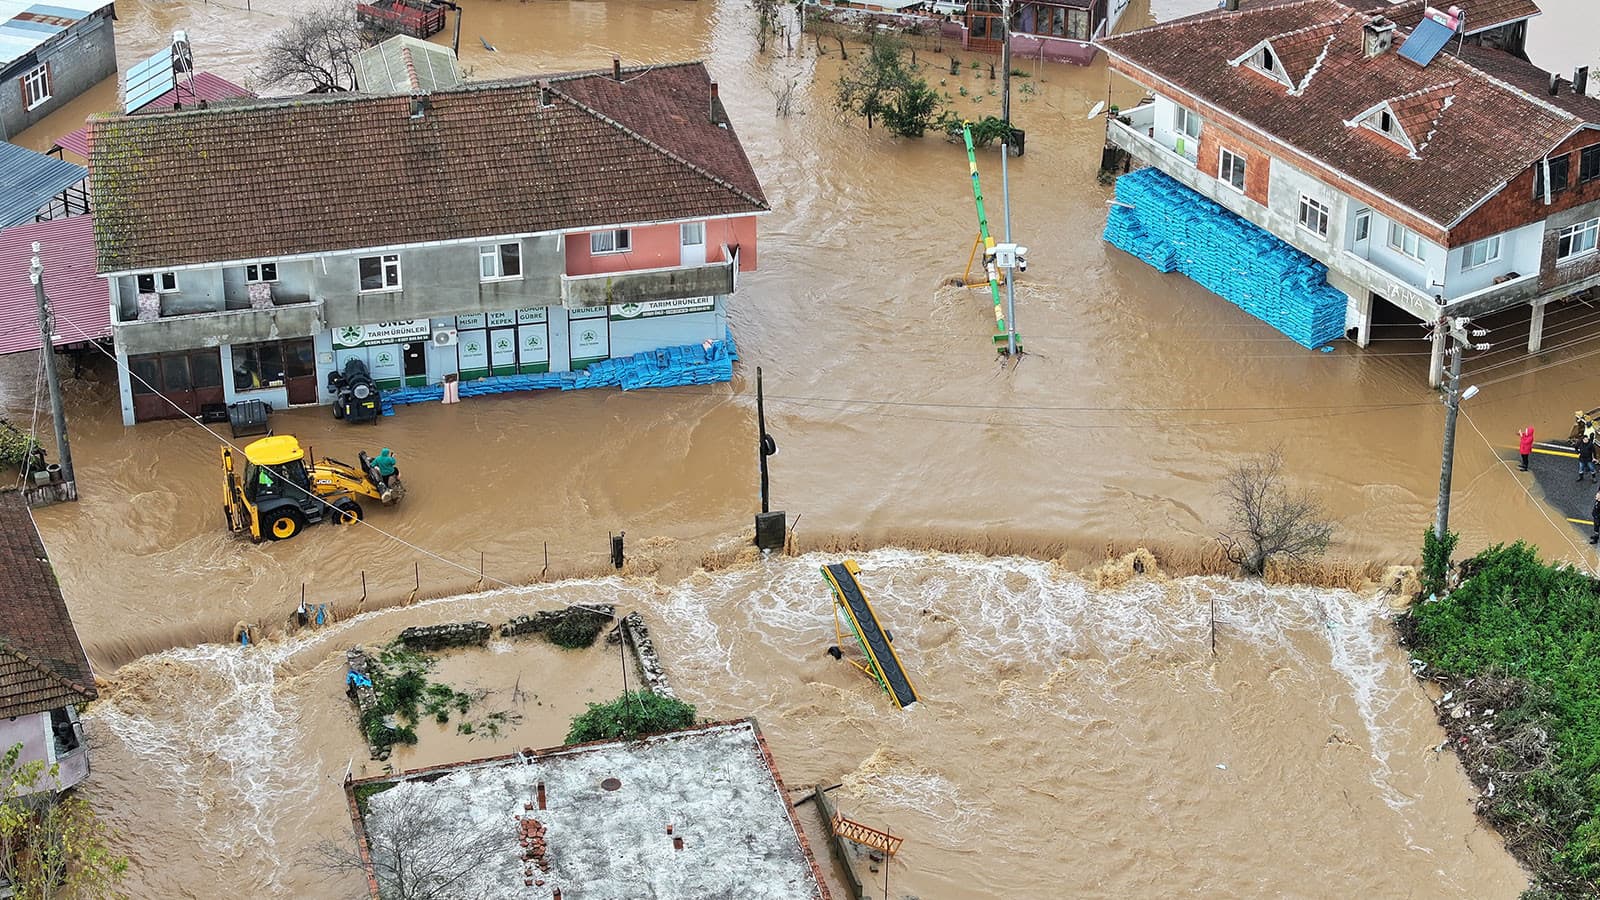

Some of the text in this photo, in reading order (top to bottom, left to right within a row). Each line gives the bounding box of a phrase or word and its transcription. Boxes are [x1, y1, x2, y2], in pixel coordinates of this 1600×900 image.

[1386, 279, 1425, 311] YAHYA
[367, 325, 428, 338] TARIM ÜRÜNLERİ
